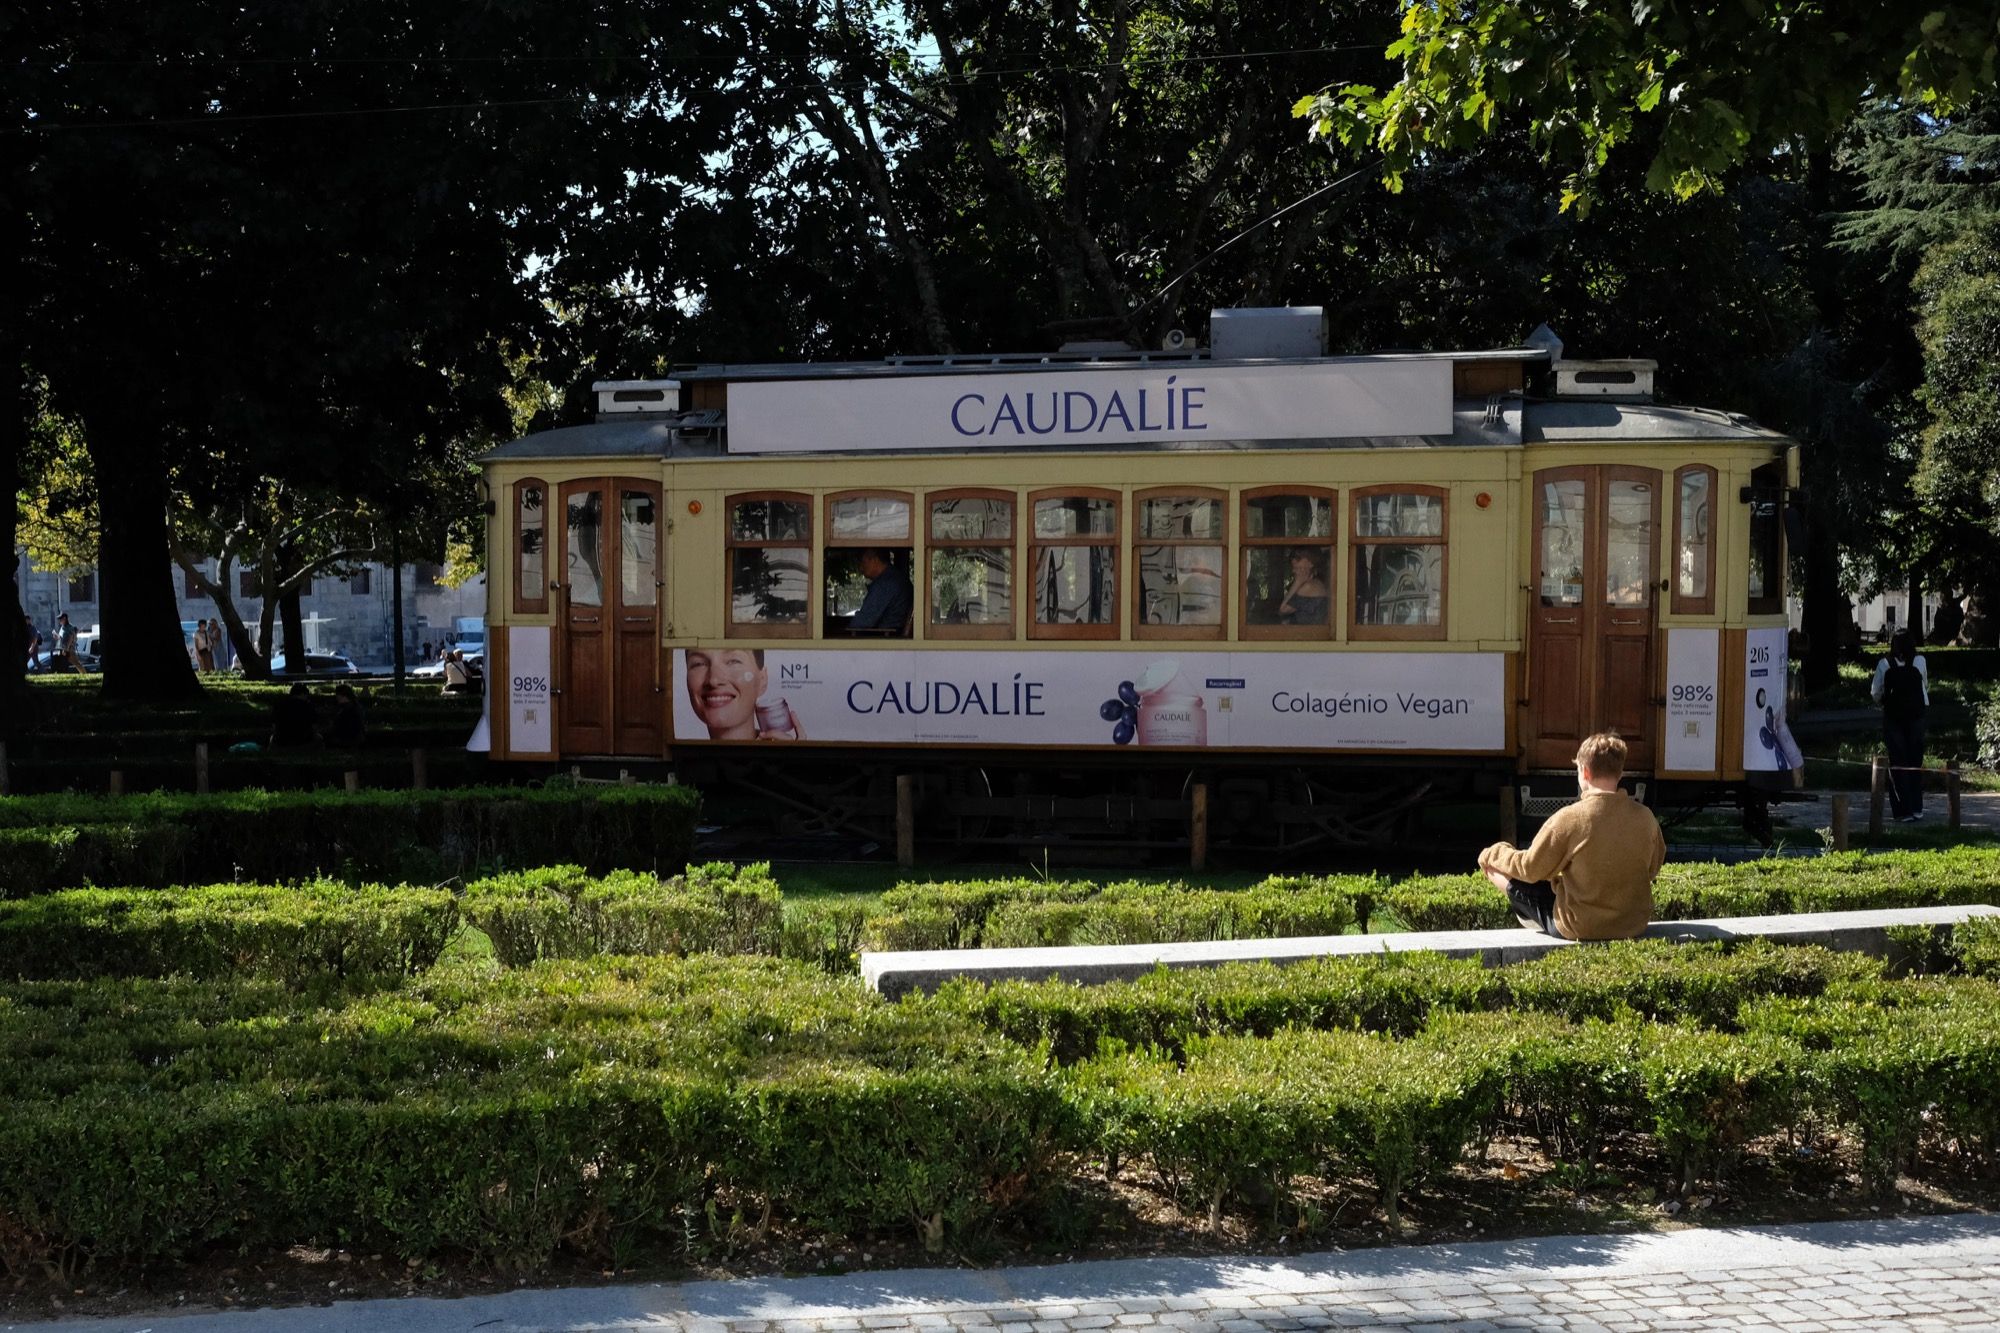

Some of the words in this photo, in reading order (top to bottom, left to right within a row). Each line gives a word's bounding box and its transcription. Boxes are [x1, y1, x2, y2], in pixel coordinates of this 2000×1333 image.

[950, 375, 1208, 436] CAUDALÍE
[1750, 646, 1770, 664] 205
[513, 676, 547, 692] 98%
[846, 672, 1046, 716] CAUDALÍE
[1671, 684, 1714, 702] 98%
[1271, 691, 1389, 718] Colagénio
[1396, 692, 1469, 719] Vegan
